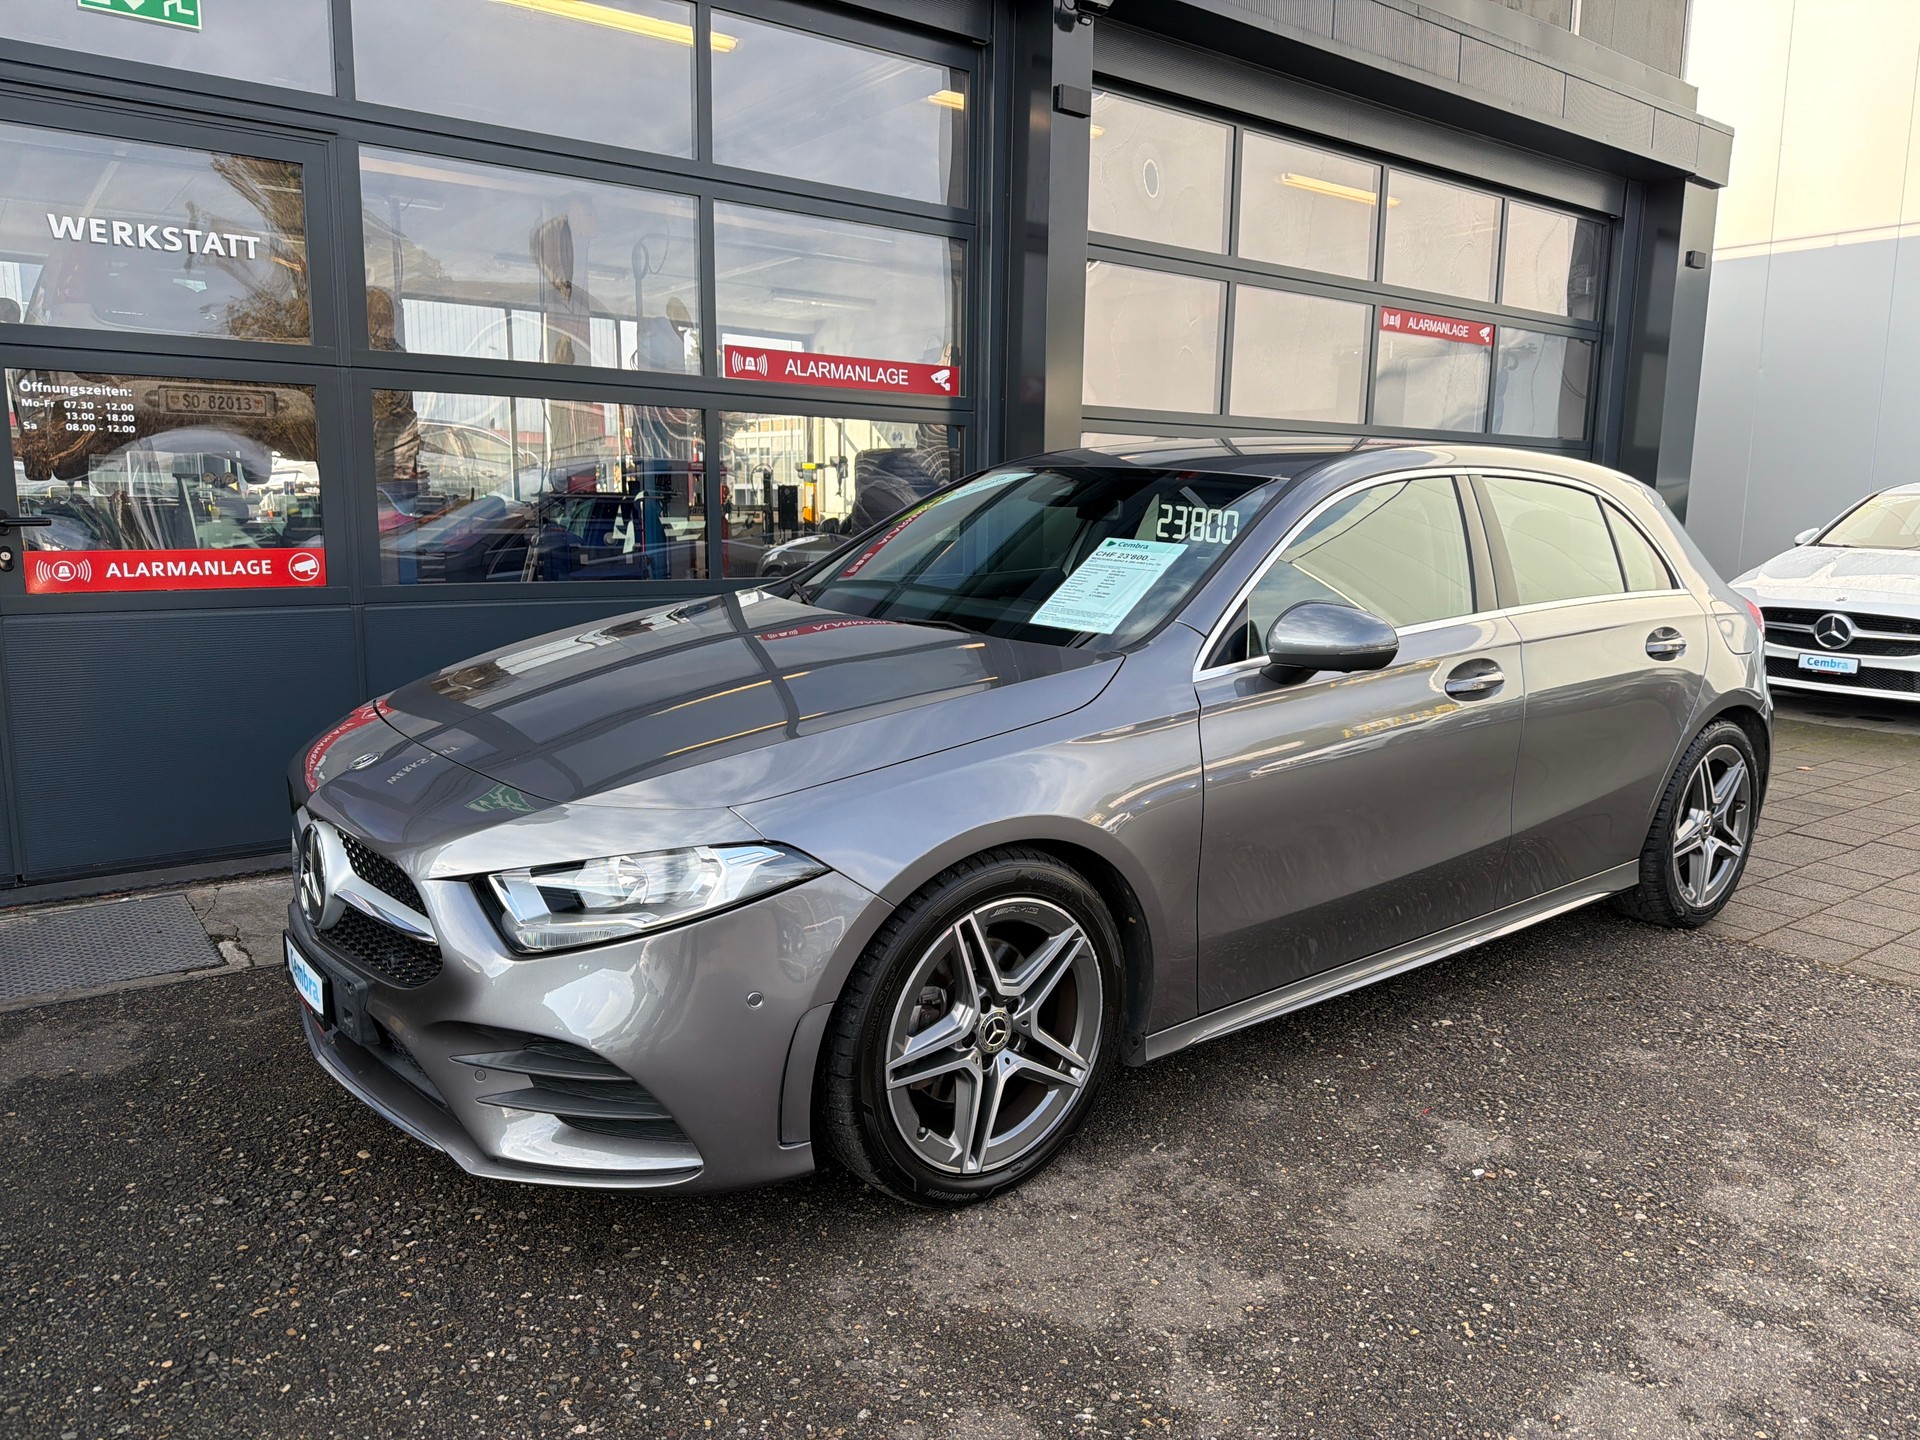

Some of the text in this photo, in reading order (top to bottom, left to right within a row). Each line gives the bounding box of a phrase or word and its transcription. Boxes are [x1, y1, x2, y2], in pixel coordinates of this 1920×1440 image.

[47, 213, 260, 260] WERKSTATT
[1407, 316, 1470, 338] ALARMANLAGE
[785, 358, 909, 385] ALARMANLAGE
[19, 379, 133, 398] Öffnungszeiten:
[21, 399, 56, 408] Mo-Fr
[63, 400, 94, 409] 07.30
[105, 402, 134, 412] 12.00
[65, 412, 95, 421] 13.00
[106, 413, 135, 422] 18.00
[23, 421, 38, 430] Sa
[65, 423, 96, 432] 08.00
[107, 425, 136, 433] 12.00
[1118, 541, 1149, 550] Cembra
[1095, 550, 1117, 558] CHF
[105, 559, 272, 578] ALARMANLAGE
[1806, 657, 1849, 670] Cembra
